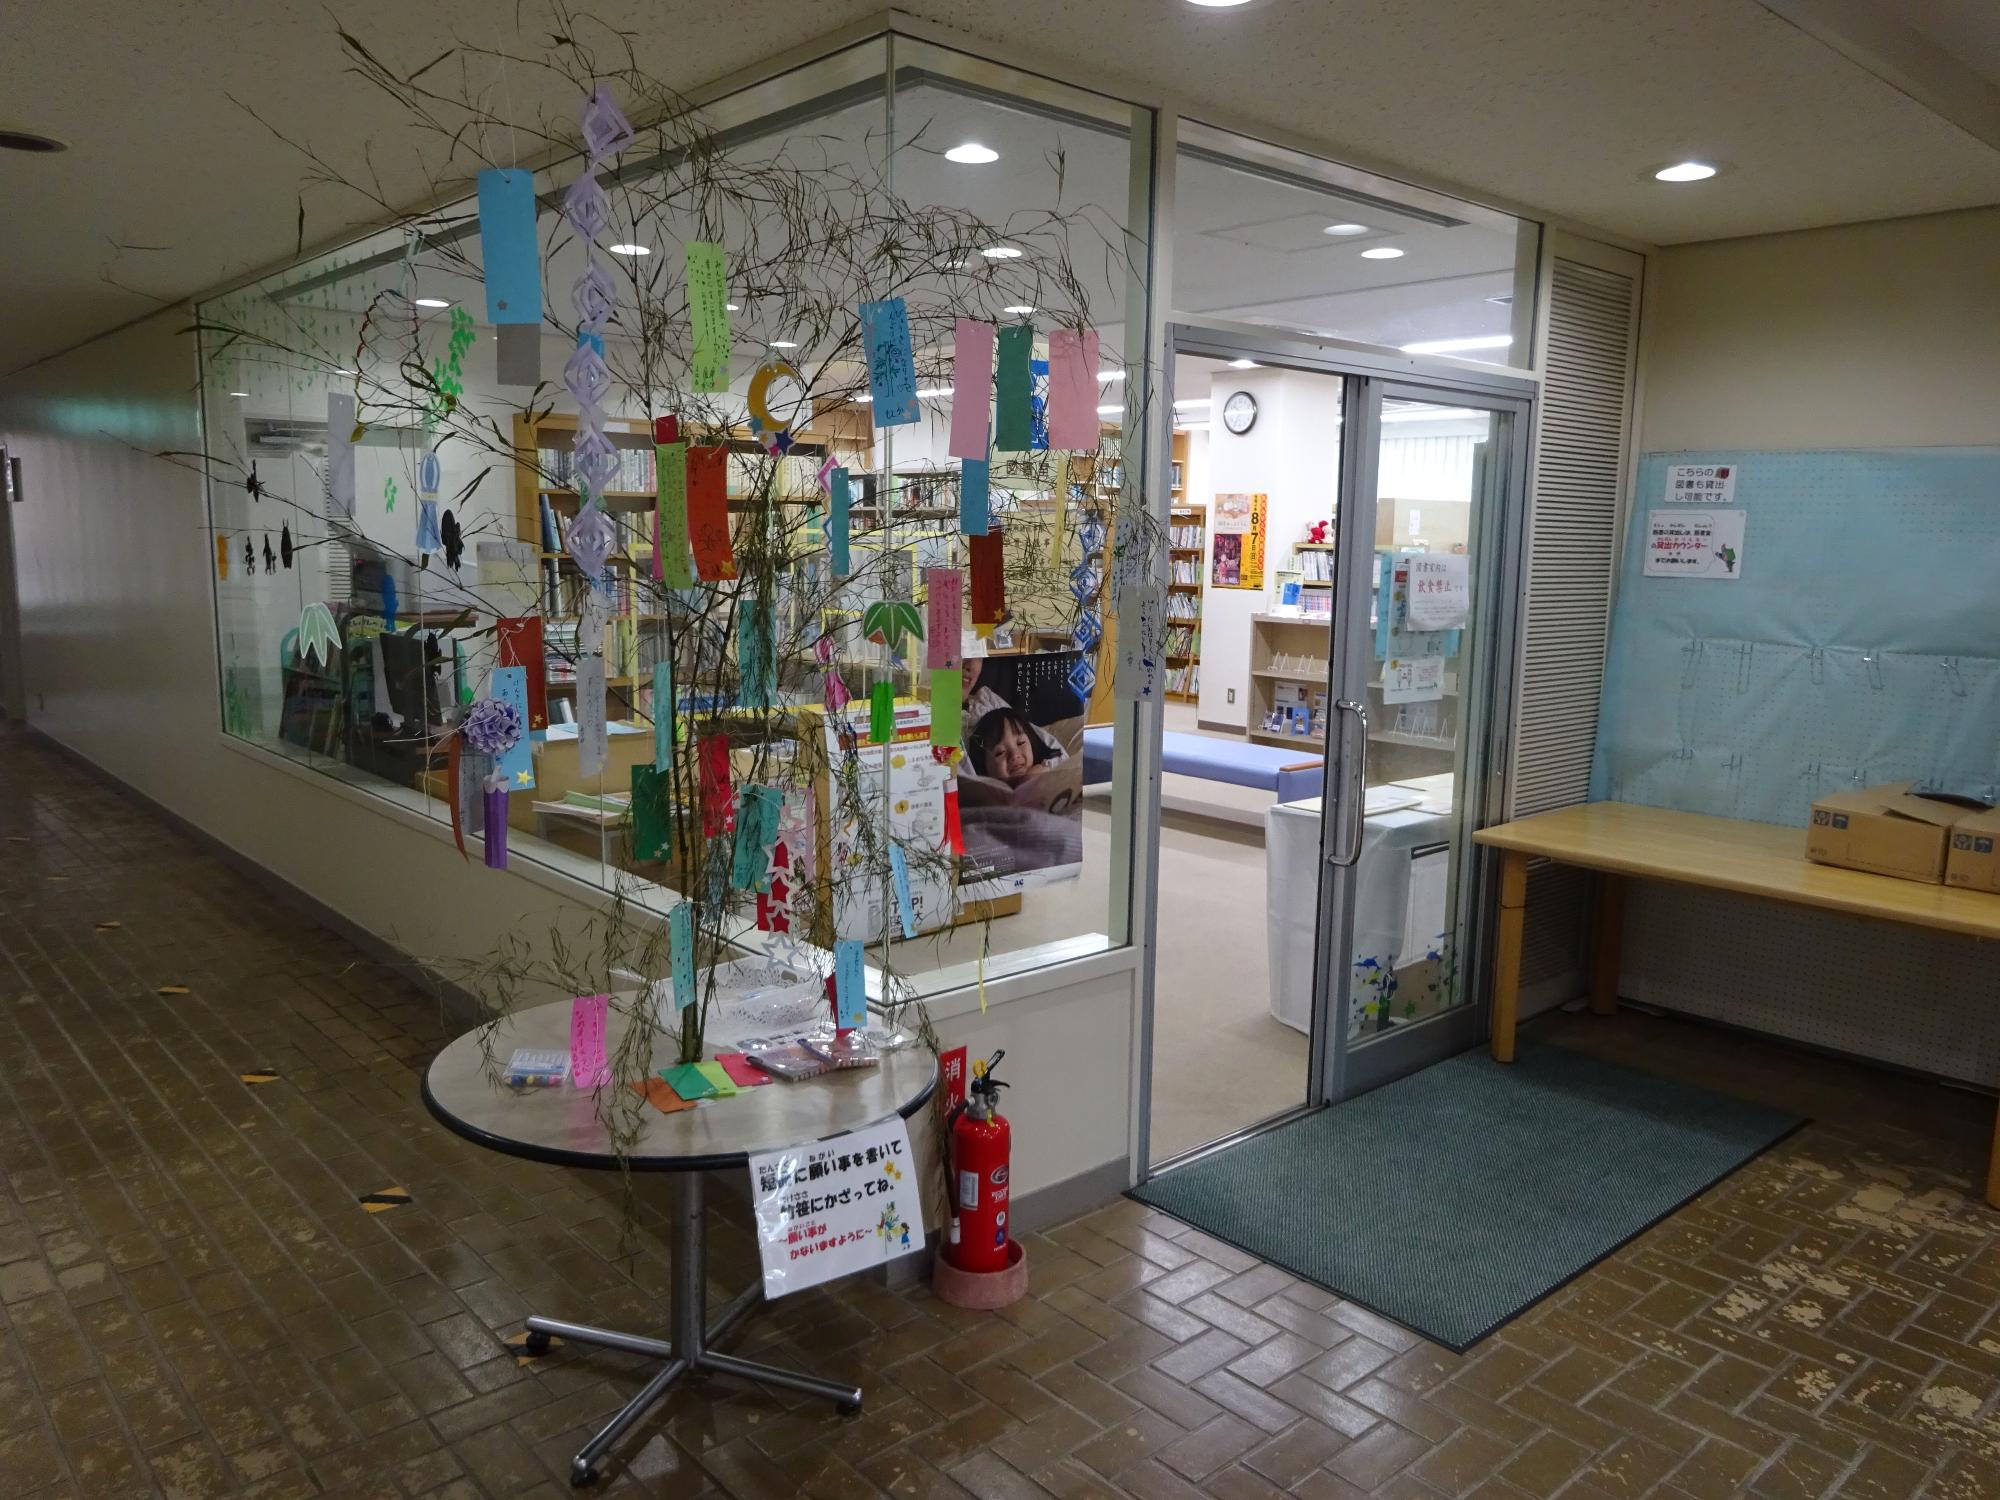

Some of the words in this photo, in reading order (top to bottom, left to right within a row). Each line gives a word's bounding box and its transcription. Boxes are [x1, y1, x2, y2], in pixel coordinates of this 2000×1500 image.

[1677, 467, 1714, 477] こちらの
[1675, 480, 1725, 489] 図書も貸出
[1675, 492, 1727, 502] し可能です。
[808, 1149, 835, 1163] ねがい
